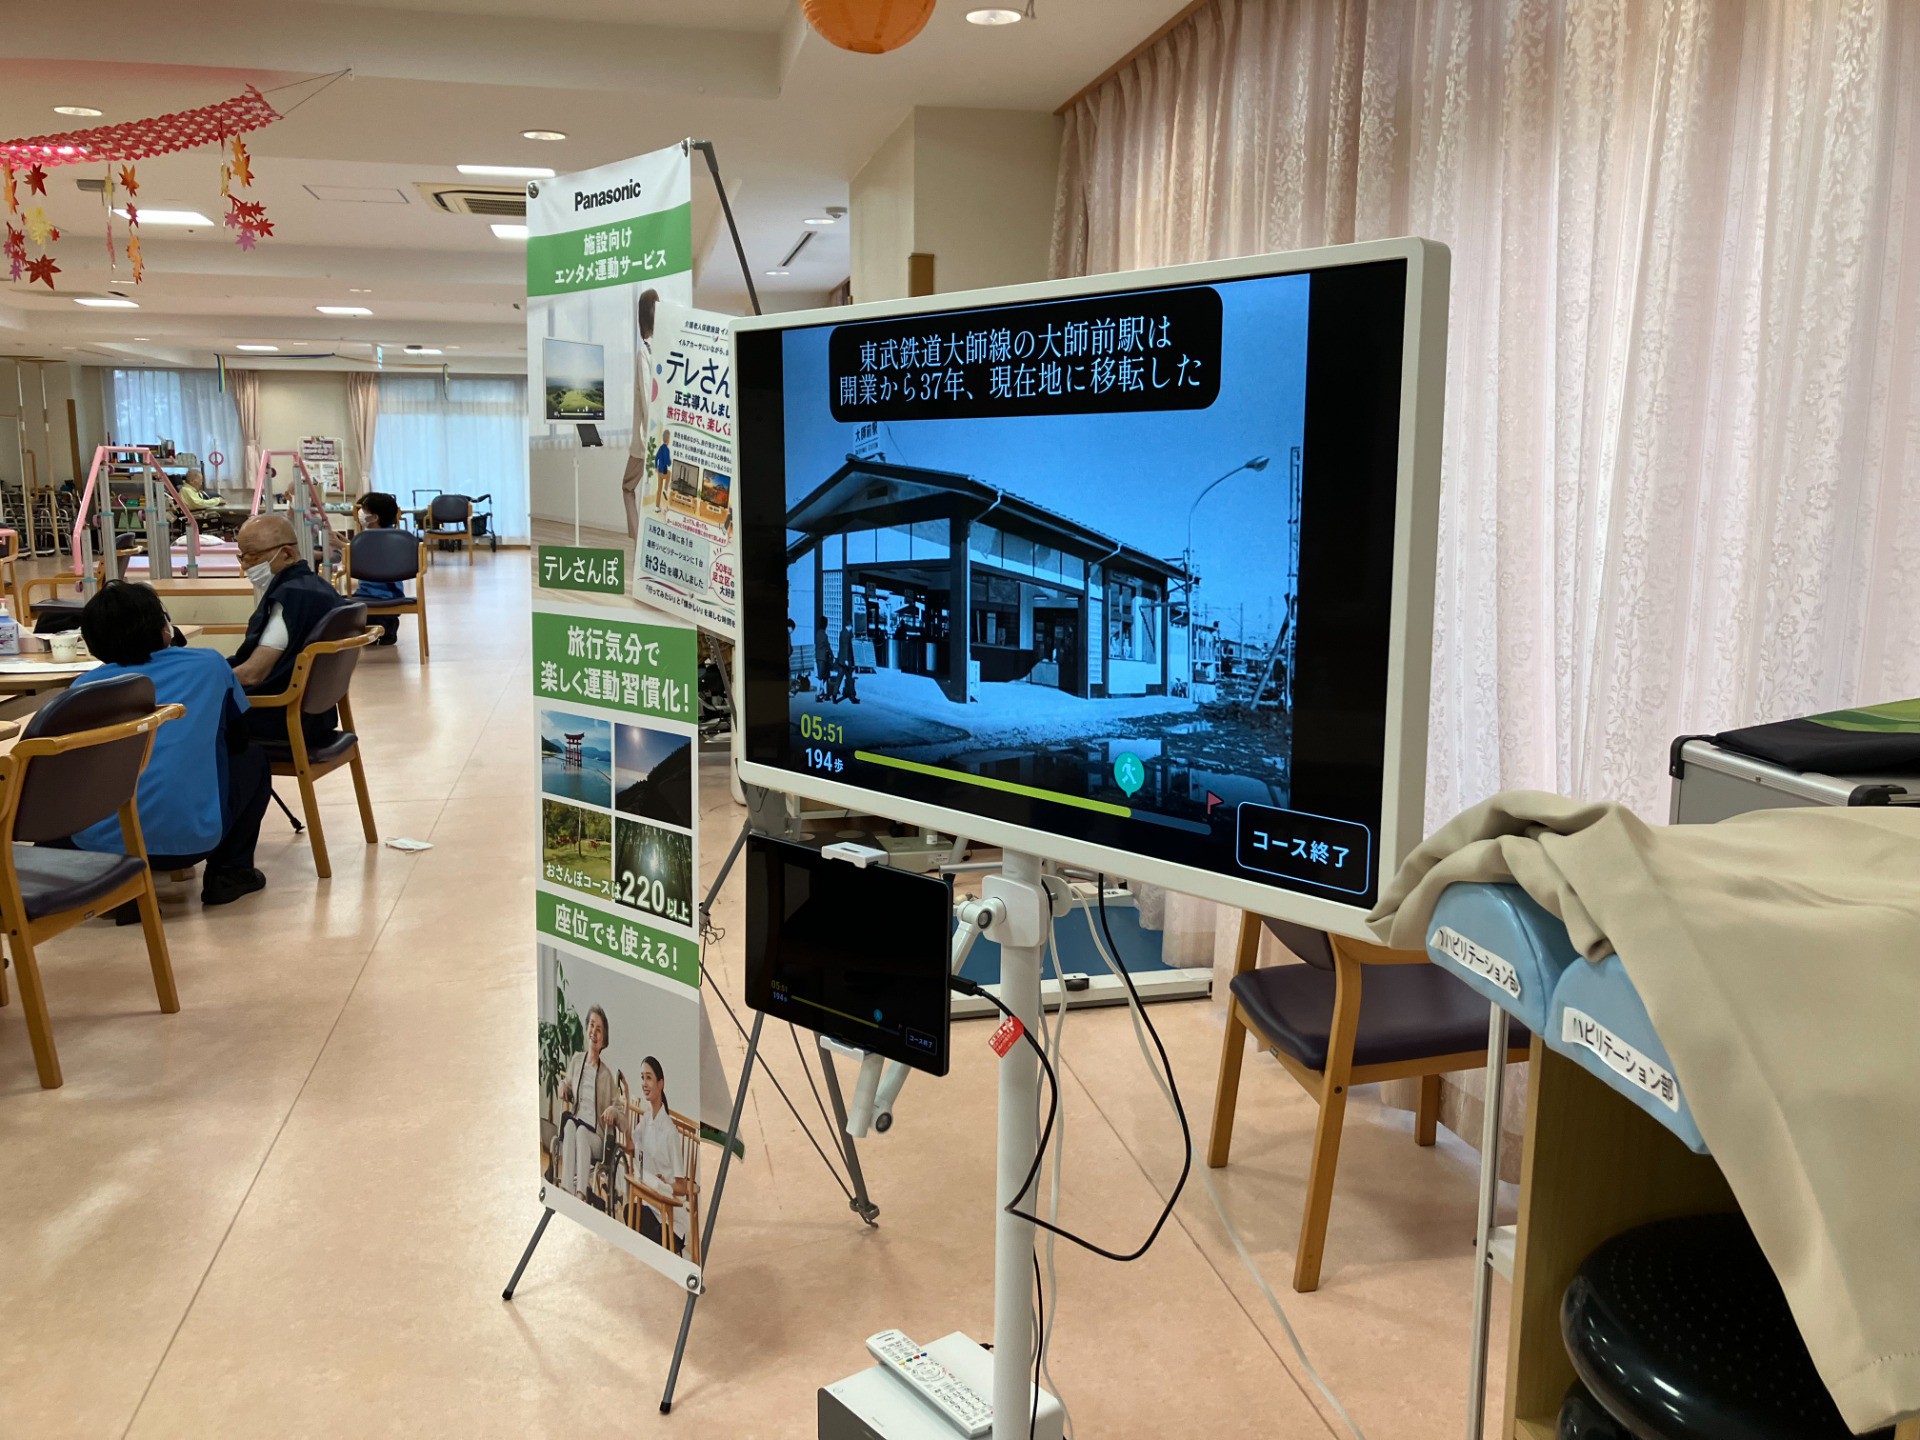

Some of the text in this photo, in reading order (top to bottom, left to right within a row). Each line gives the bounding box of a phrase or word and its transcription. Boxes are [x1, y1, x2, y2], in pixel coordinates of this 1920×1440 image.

[574, 178, 642, 212] Panasonic
[583, 227, 632, 256] 施設向け
[554, 249, 667, 285] エンタメ運動サービス
[859, 315, 1172, 372] 東武鉄道大師線の大師前駅は
[839, 354, 1202, 407] 開業から37年、現在地に移転した
[544, 555, 619, 586] テレさんぽ
[645, 554, 704, 589] 計3台を導入しました
[567, 624, 660, 667] 旅行気分で
[540, 660, 689, 713] 楽しく運動習慣化!
[800, 713, 843, 744] 05:51
[805, 747, 844, 773] 194歩
[1252, 830, 1350, 868] コース終了
[555, 903, 678, 972] 座位でも使える!
